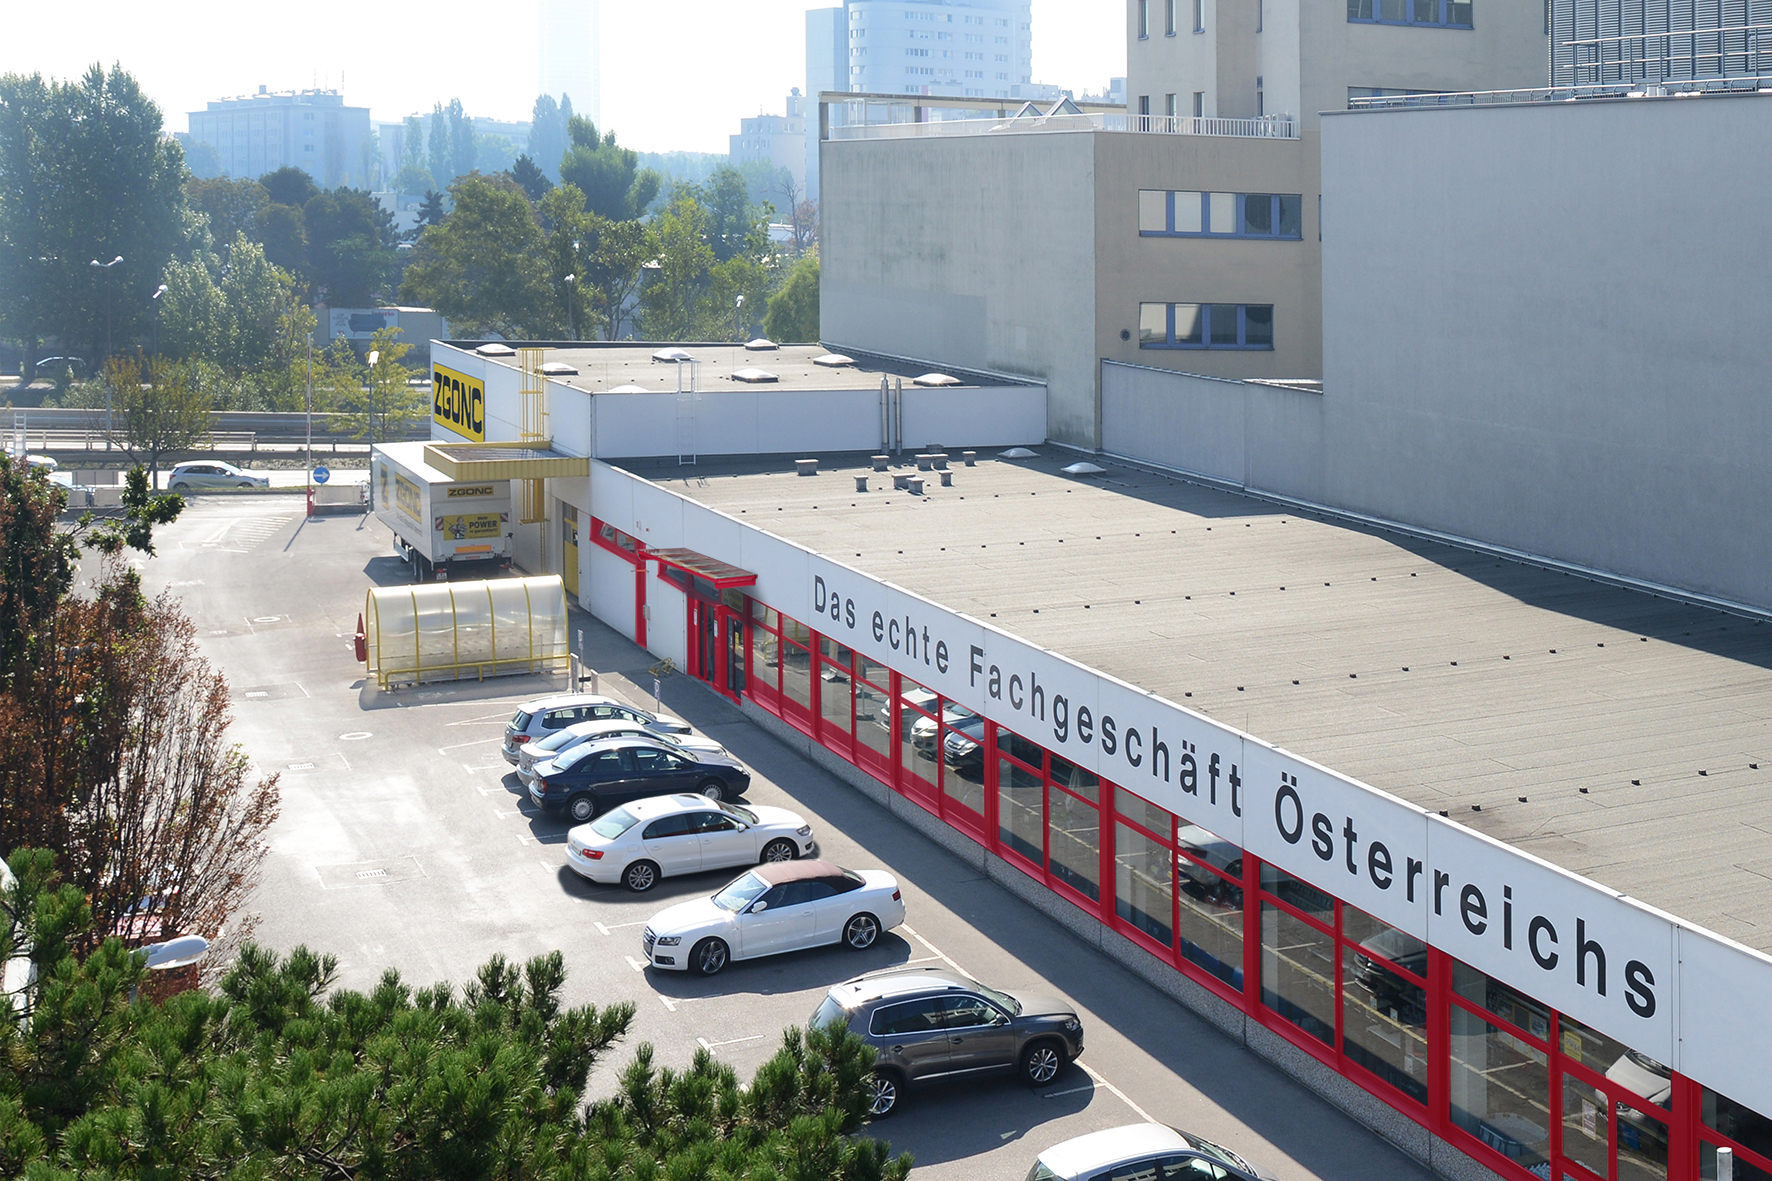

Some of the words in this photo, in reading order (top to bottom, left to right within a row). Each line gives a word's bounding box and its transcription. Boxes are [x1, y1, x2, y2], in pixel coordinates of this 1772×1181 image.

[434, 372, 482, 434] ZGONC
[449, 487, 493, 496] ZGONC
[469, 520, 497, 529] POWER
[814, 574, 856, 629] Das
[872, 614, 949, 674] echte
[969, 645, 1242, 818] Fachgeschäft
[1274, 771, 1657, 1019] Österreichs
